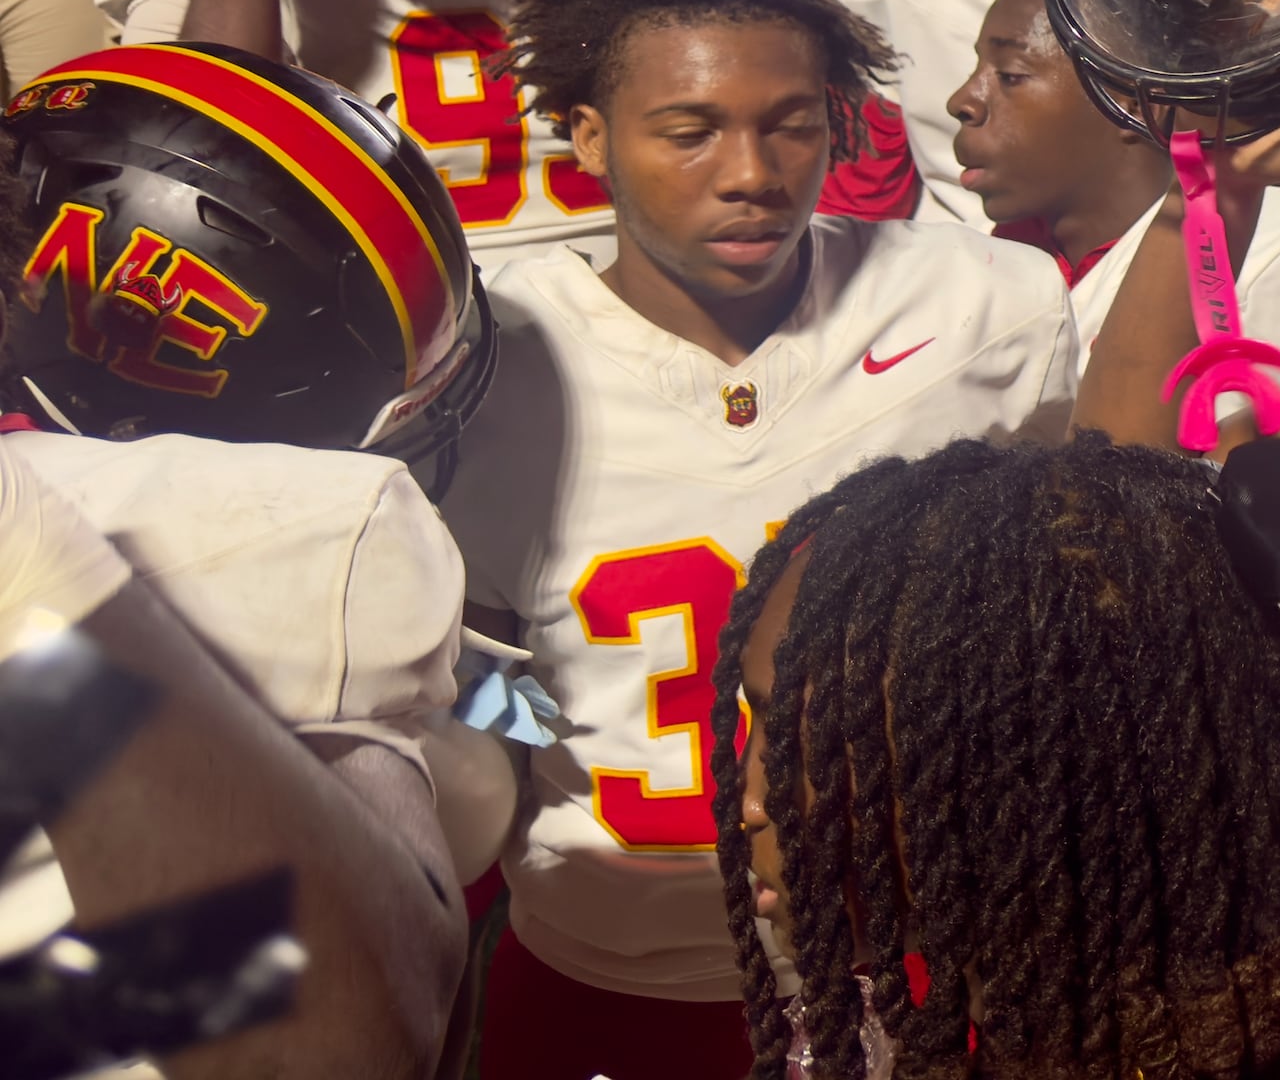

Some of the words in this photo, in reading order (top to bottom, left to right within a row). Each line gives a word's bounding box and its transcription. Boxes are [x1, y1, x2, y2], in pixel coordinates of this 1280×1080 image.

[389, 9, 612, 228] 9
[22, 202, 268, 399] NE
[568, 522, 775, 853] 3
